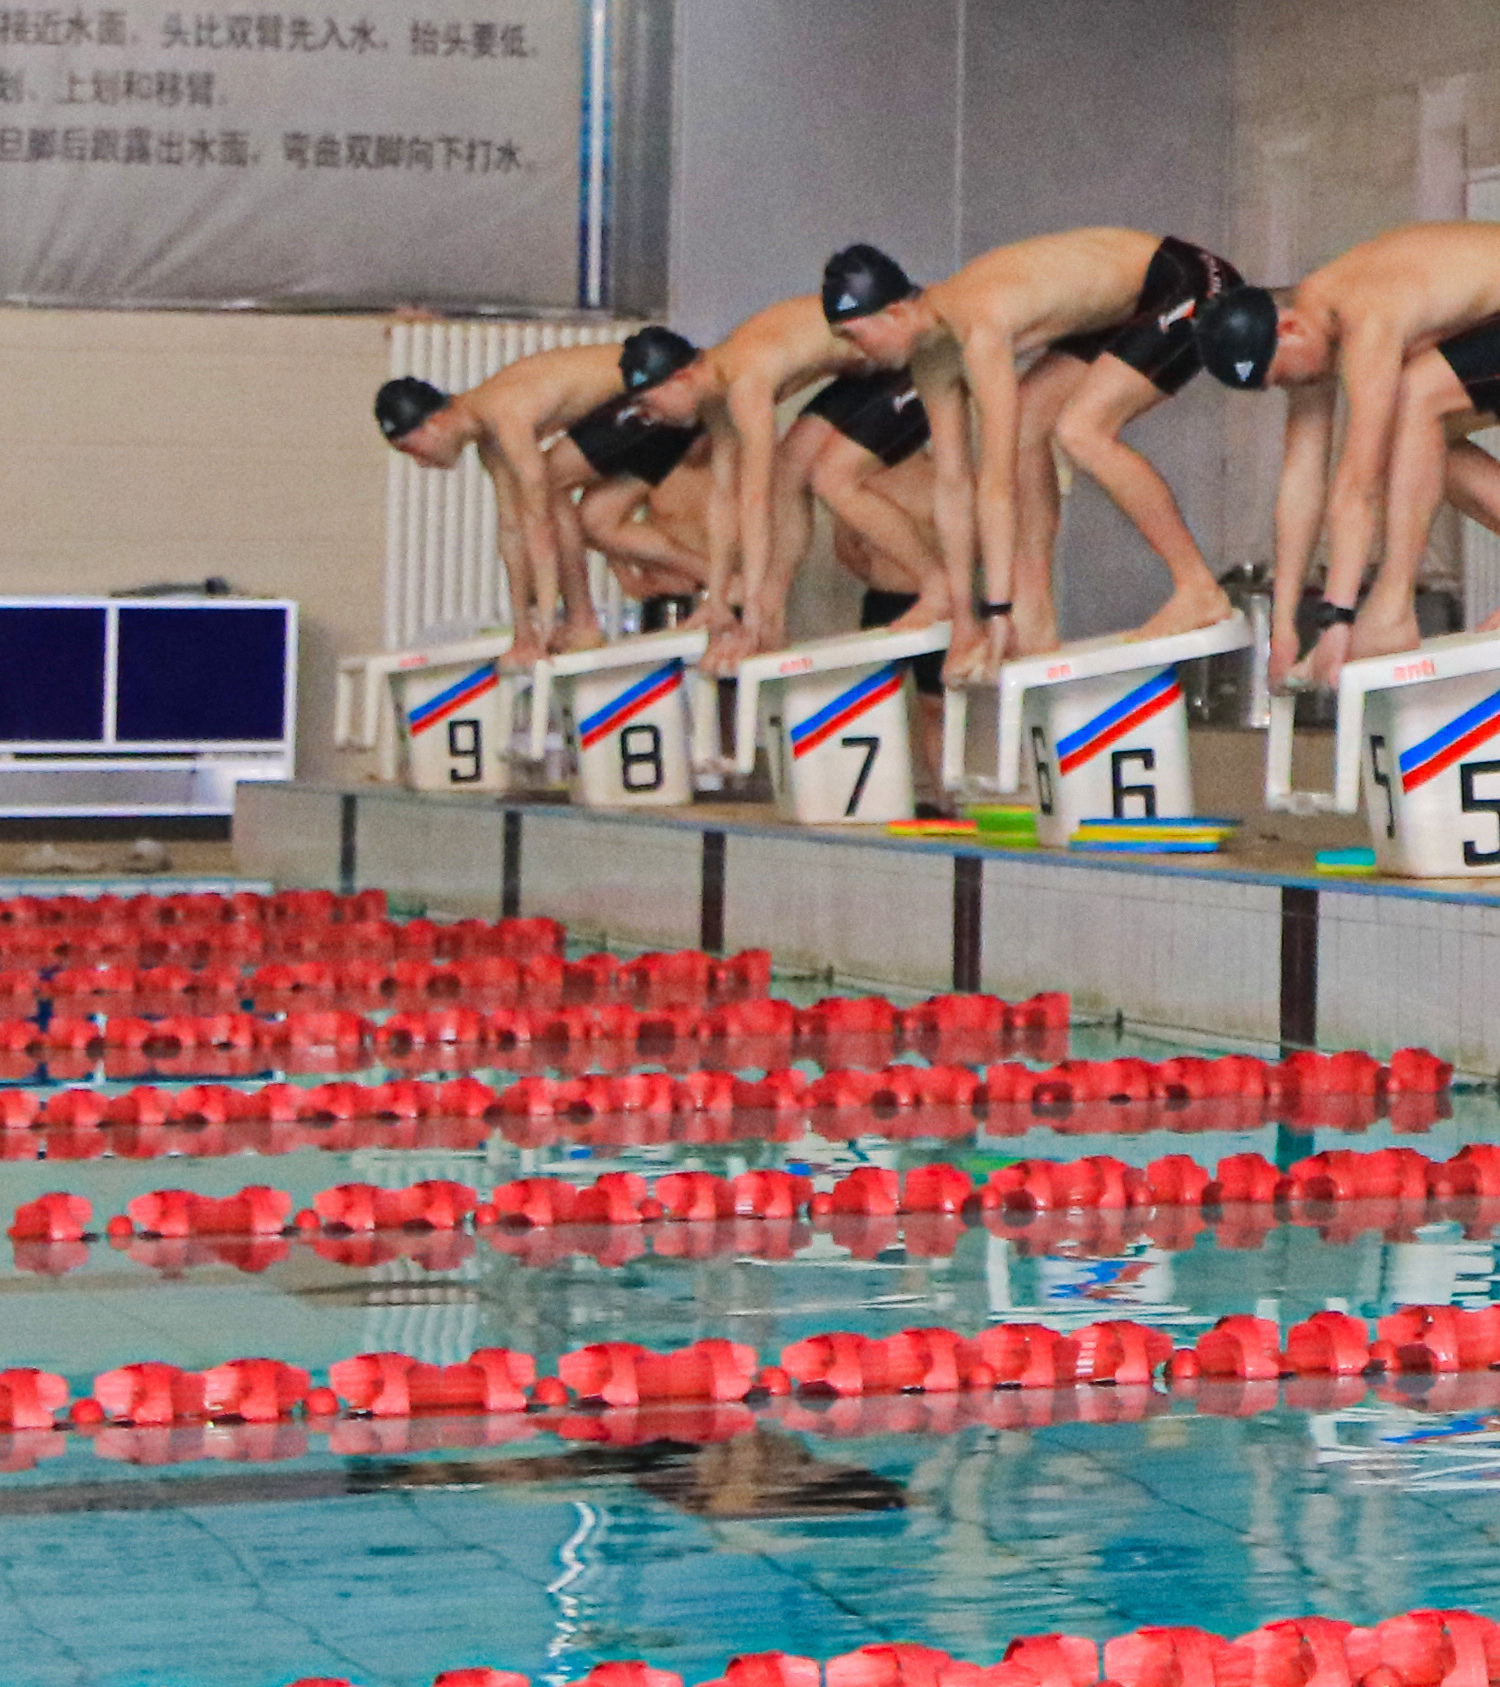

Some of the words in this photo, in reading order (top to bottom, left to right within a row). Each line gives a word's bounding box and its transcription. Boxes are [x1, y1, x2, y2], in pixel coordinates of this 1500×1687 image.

[448, 719, 482, 783] 9
[620, 724, 663, 792] 8
[841, 736, 880, 817] 7
[1111, 748, 1157, 819] 6
[1370, 734, 1395, 839] 5
